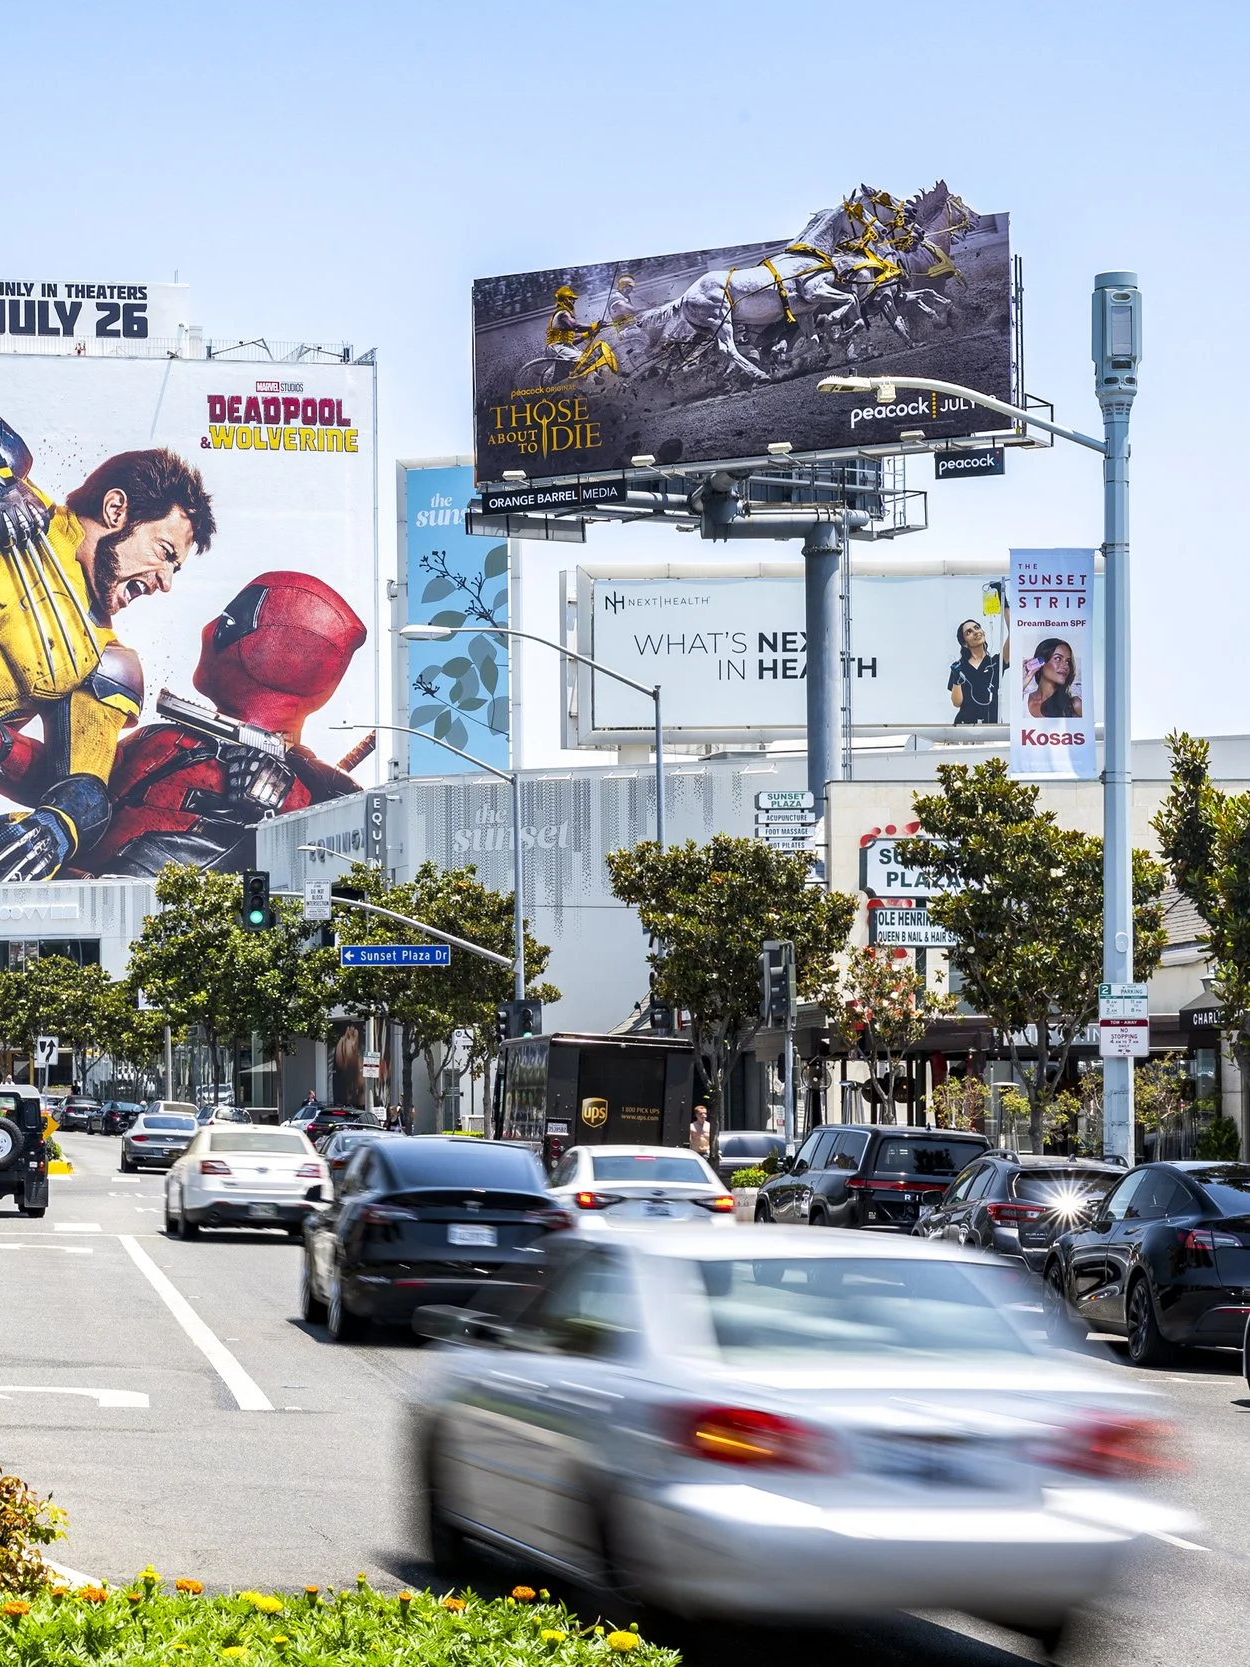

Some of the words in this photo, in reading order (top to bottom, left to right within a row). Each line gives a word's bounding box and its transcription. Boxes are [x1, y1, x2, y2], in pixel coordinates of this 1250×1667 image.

[41, 283, 58, 298] IN
[65, 284, 148, 300] THEATERS
[95, 302, 148, 338] 26
[256, 382, 279, 392] MARVEL
[280, 383, 304, 393] STUDIOS
[511, 386, 544, 399] peacock
[546, 384, 576, 393] ORIGINAL
[207, 395, 351, 427] DEADPOOL
[490, 398, 589, 429] THOSE
[850, 396, 930, 429] peacock
[940, 397, 977, 412] JULY
[209, 425, 359, 453] WOLVERINE
[487, 429, 538, 445] ABOUT
[551, 422, 603, 452] DIE
[518, 442, 538, 454] TO
[939, 453, 995, 476] peacock
[430, 493, 453, 508] the
[489, 495, 535, 508] ORANGE
[537, 490, 578, 504] BARREL
[582, 486, 618, 499] MEDIA
[416, 507, 466, 528] suns
[1018, 574, 1087, 586] SUNSET
[1018, 596, 1087, 609] STRIP
[1017, 619, 1069, 627] DreamBeam
[1070, 619, 1087, 627] SPF
[634, 631, 748, 656] WHAT'S
[757, 631, 807, 653] NE
[718, 659, 746, 680] IN
[757, 657, 878, 680] HETH
[1021, 729, 1086, 746] Kosas
[475, 802, 507, 824] the
[371, 798, 383, 868] EQUIN
[452, 820, 571, 852] sunset
[878, 911, 896, 926] OLE
[898, 911, 930, 926] HENRI
[878, 931, 900, 942] QUEEN
[902, 931, 906, 942] B
[907, 931, 923, 942] NAIL
[924, 931, 929, 942] &
[931, 931, 947, 942] HAIR
[360, 950, 397, 961] Sunset
[402, 950, 430, 961] Plaza
[435, 950, 447, 960] Dr
[1101, 985, 1109, 994] 2
[583, 1106, 606, 1123] ups
